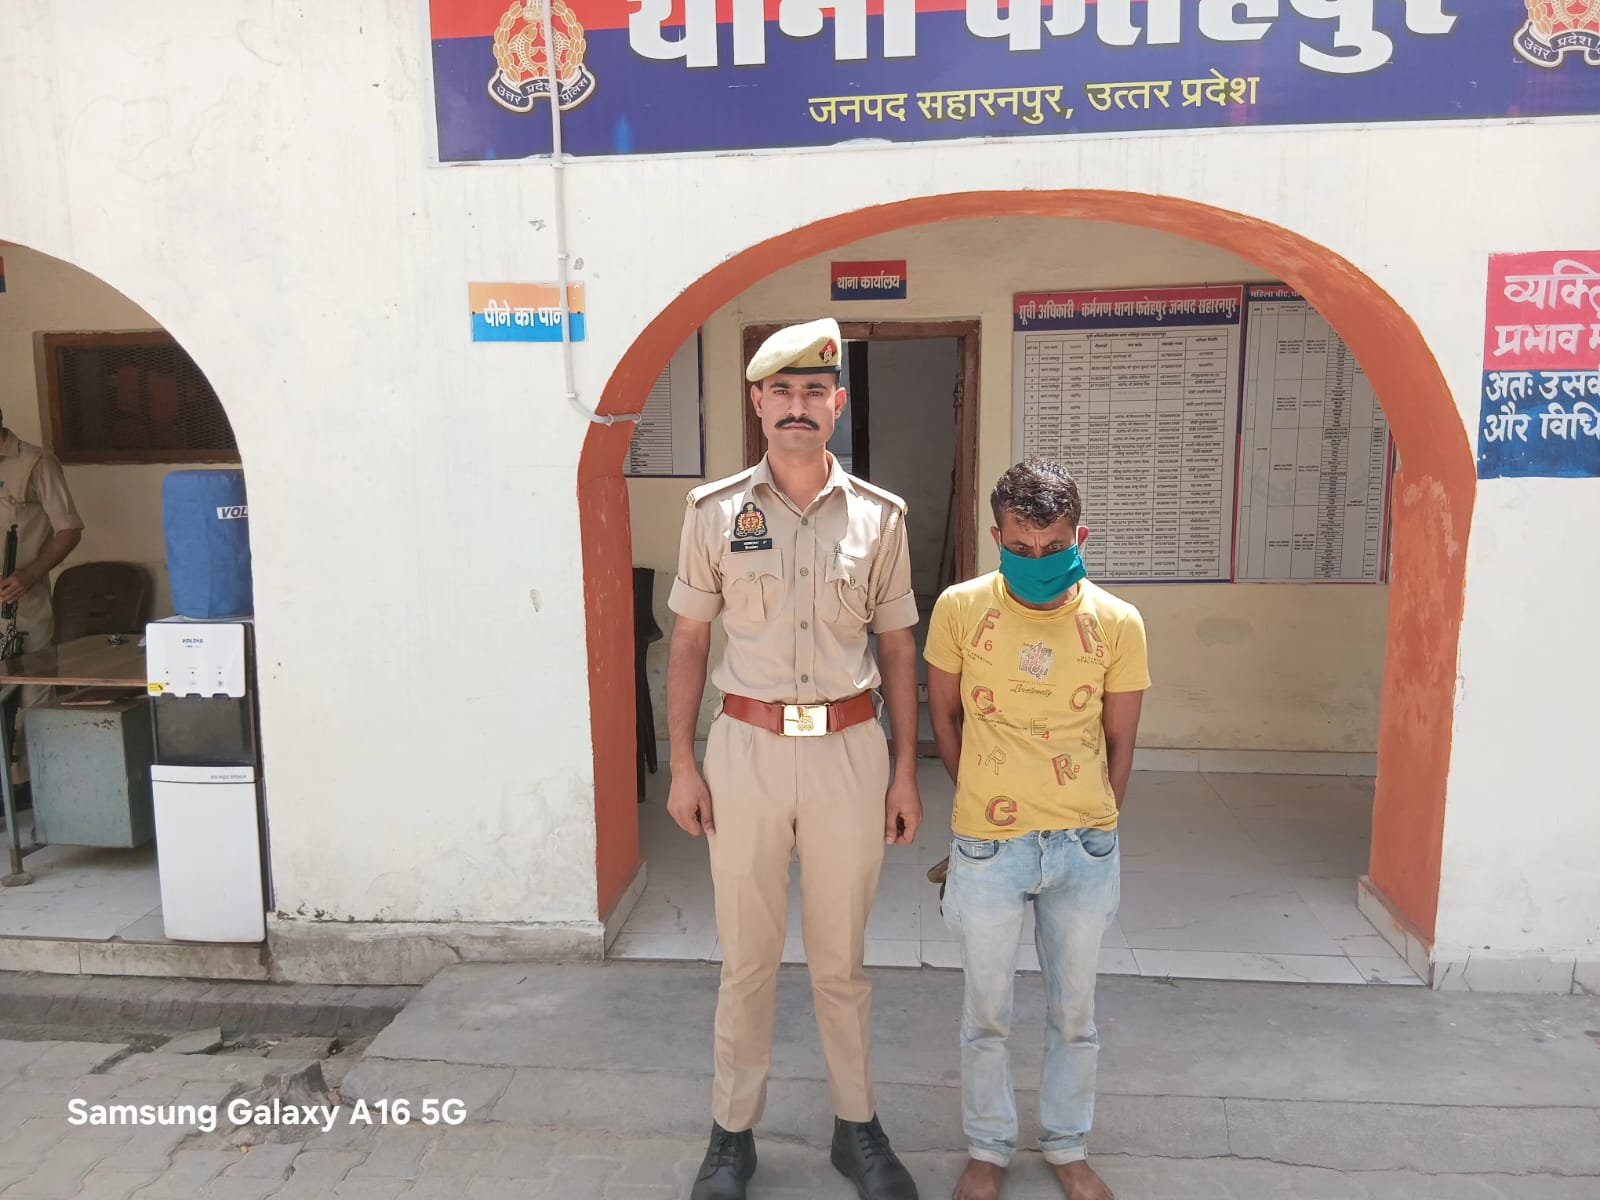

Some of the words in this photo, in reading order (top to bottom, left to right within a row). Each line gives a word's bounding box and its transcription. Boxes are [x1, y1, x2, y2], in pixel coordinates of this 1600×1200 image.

[808, 92, 907, 124] जनपद
[916, 83, 1074, 125] सहारनपुर,
[1086, 79, 1170, 111] उत्तर
[1181, 68, 1260, 108] प्रदेश
[837, 276, 859, 290] थाना
[860, 269, 900, 289] कार्यालय
[484, 299, 512, 327] पीने
[514, 306, 536, 327] का
[1168, 299, 1197, 315] जनपद
[1493, 322, 1586, 357] प्रभाव
[1484, 401, 1532, 442] और
[221, 506, 249, 518] VOL
[971, 607, 1001, 648] F
[1074, 612, 1103, 654] R
[1051, 753, 1077, 786] R
